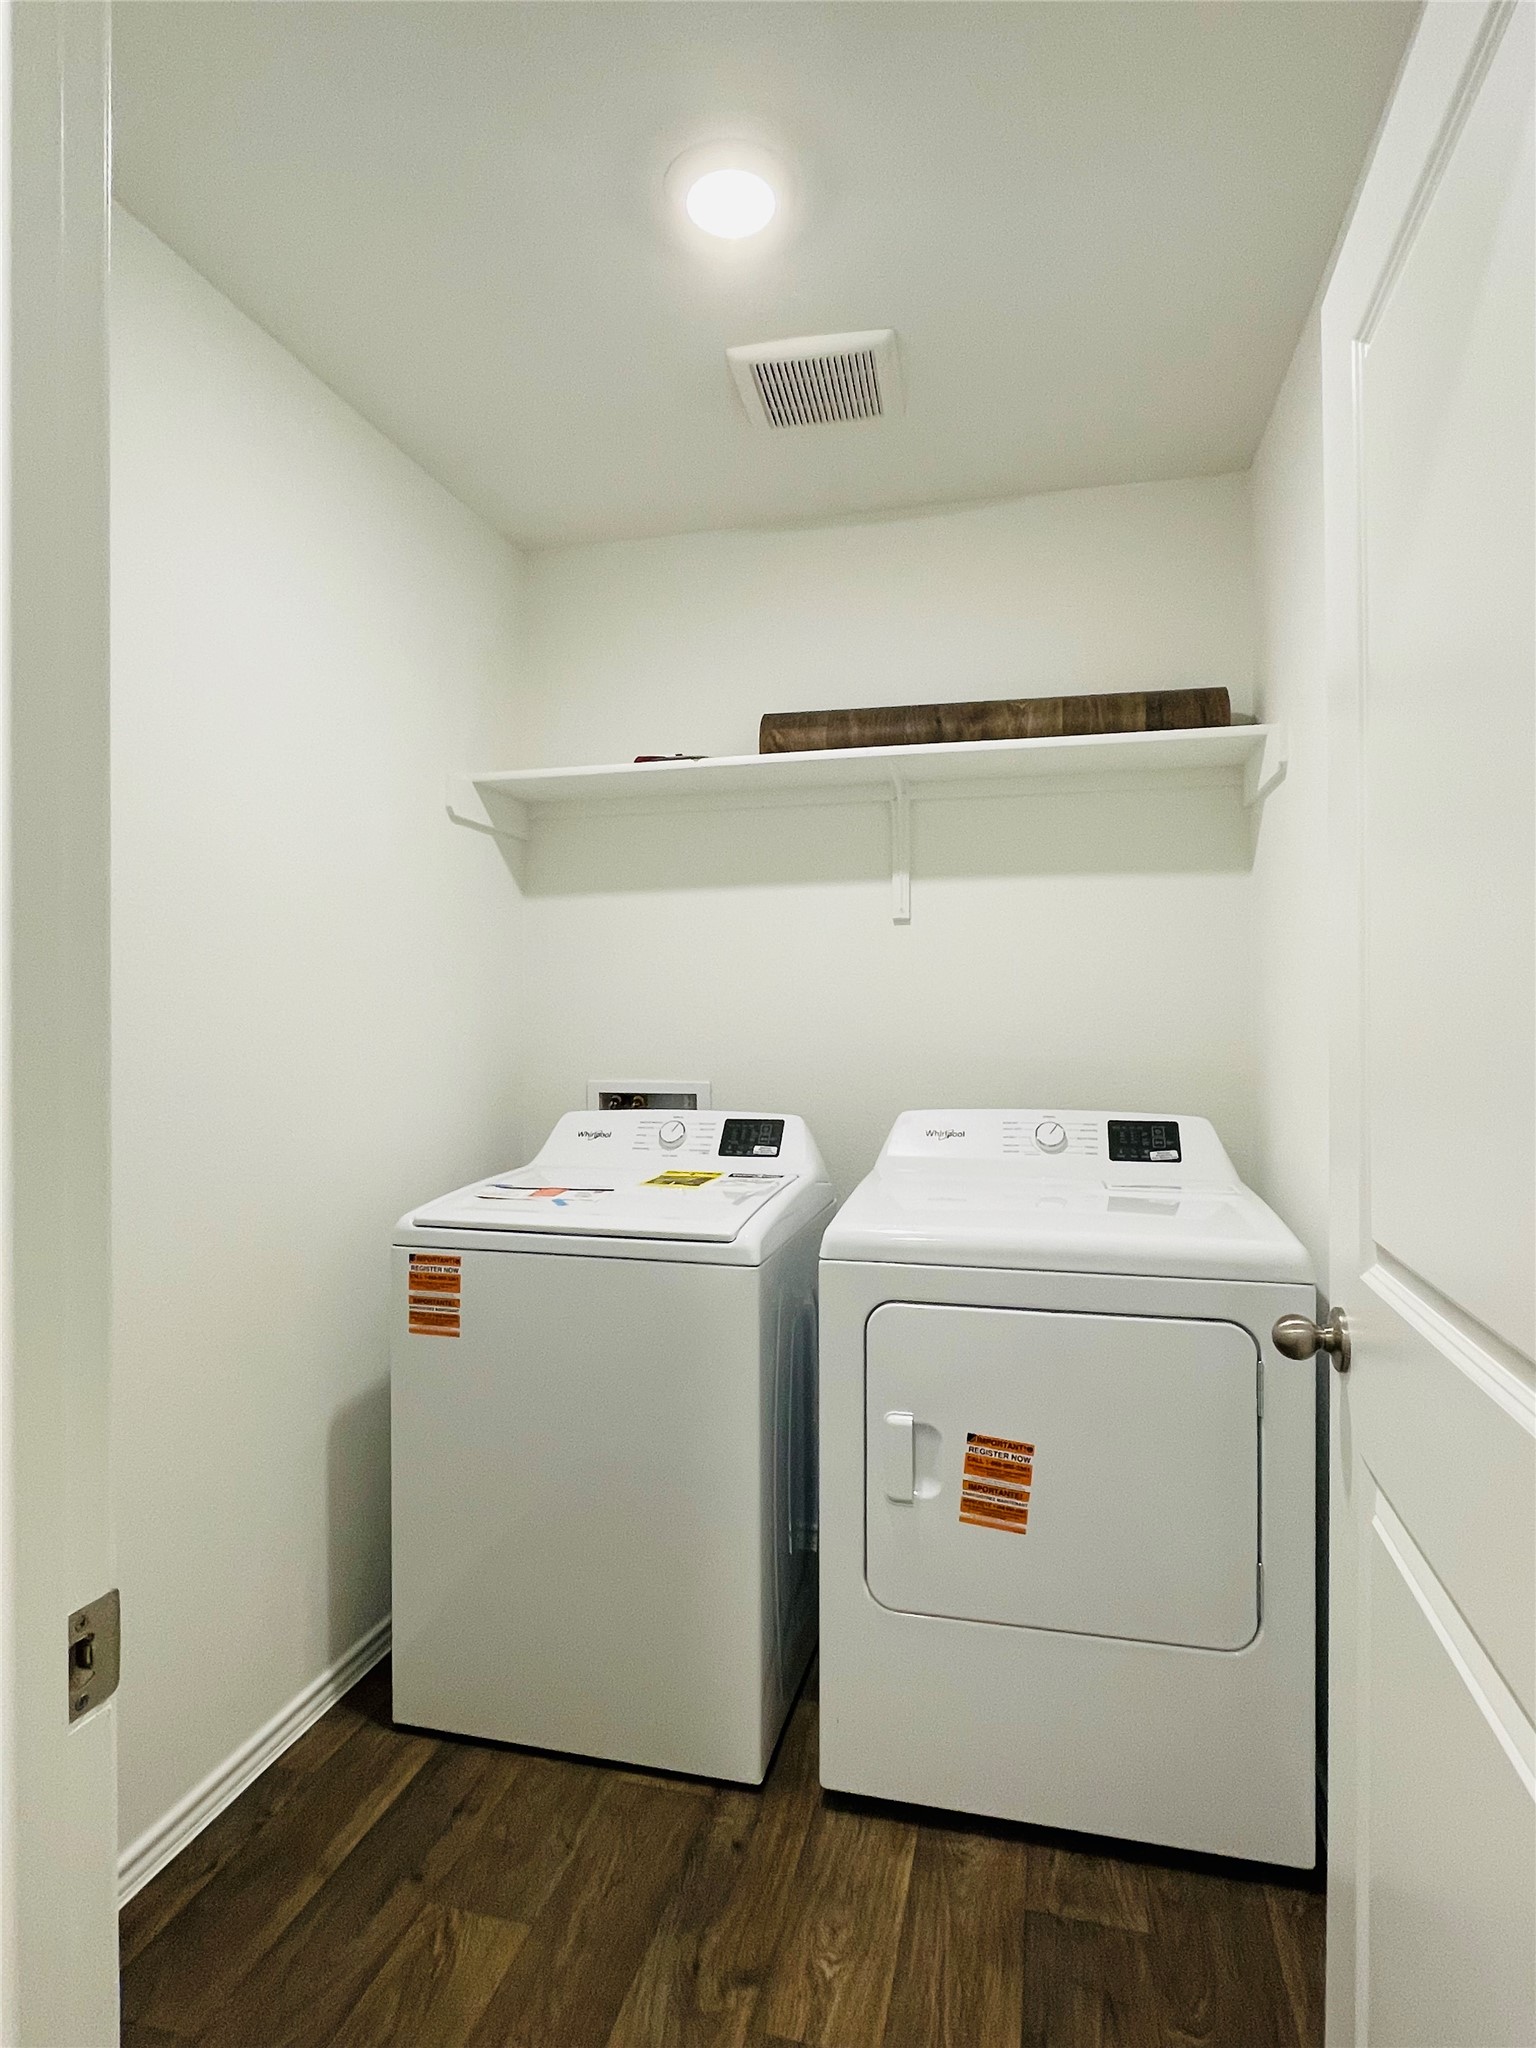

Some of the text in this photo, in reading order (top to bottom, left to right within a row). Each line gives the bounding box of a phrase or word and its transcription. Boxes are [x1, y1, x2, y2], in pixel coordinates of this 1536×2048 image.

[577, 1130, 612, 1141] Whirlpool
[925, 1129, 966, 1141] Whirlpool
[443, 1266, 460, 1274] NOW
[968, 1446, 1032, 1464] REGISTER NOW
